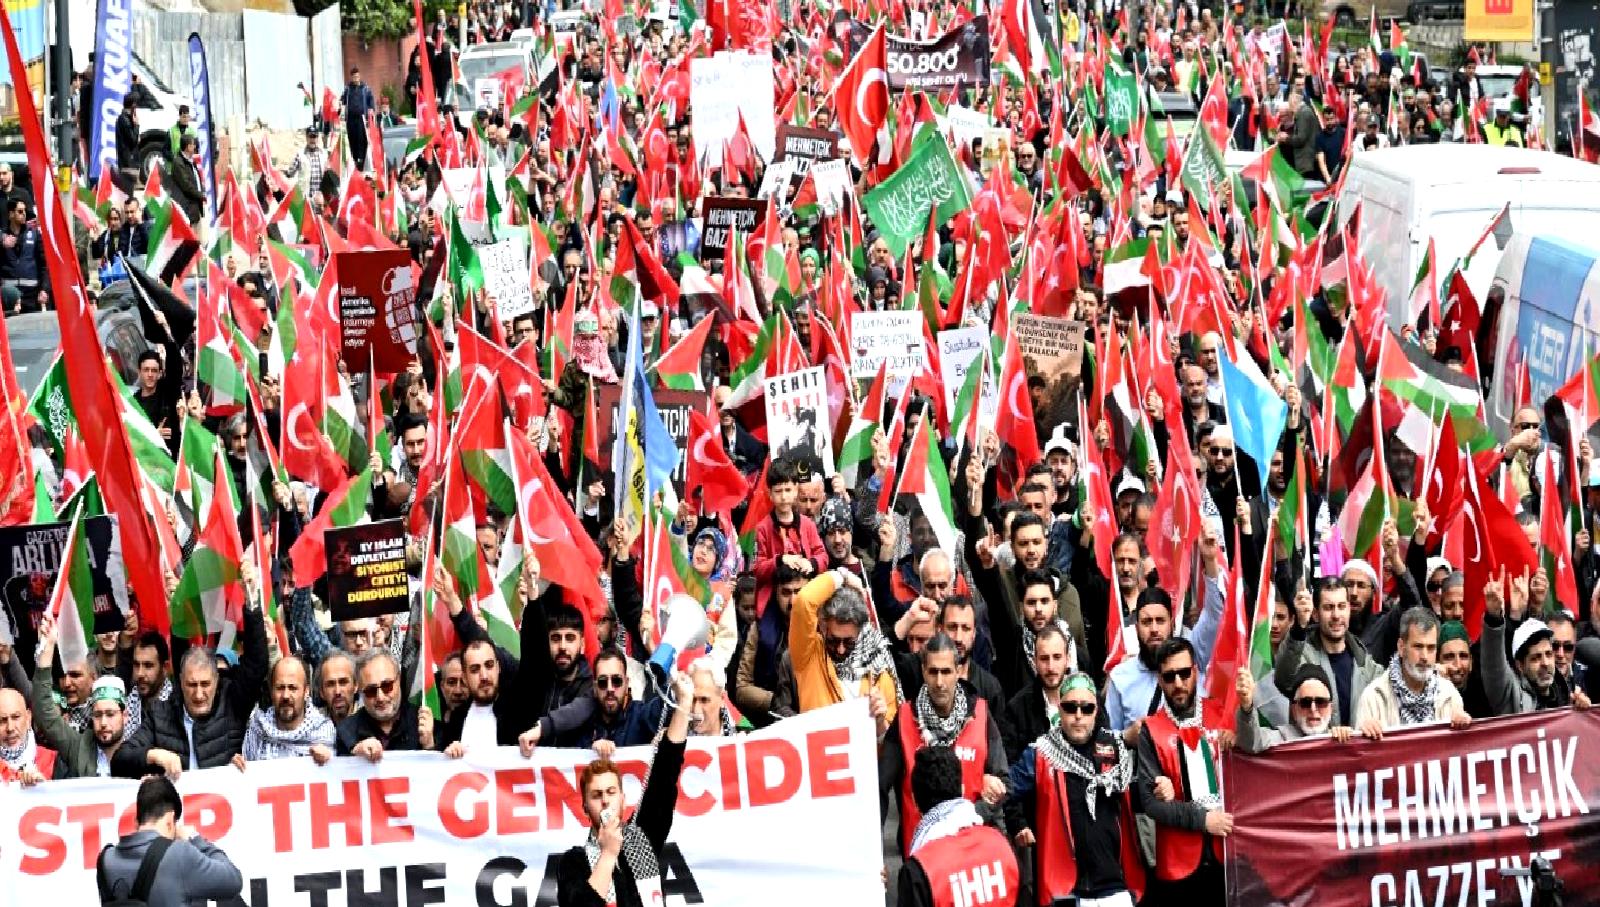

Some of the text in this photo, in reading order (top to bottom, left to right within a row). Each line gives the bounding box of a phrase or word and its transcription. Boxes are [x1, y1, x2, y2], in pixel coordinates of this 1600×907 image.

[887, 51, 958, 74] 50.800
[18, 792, 233, 875] STP
[257, 776, 415, 853] THE
[1333, 729, 1590, 850] MEHMETÇİK
[295, 862, 447, 907] THE
